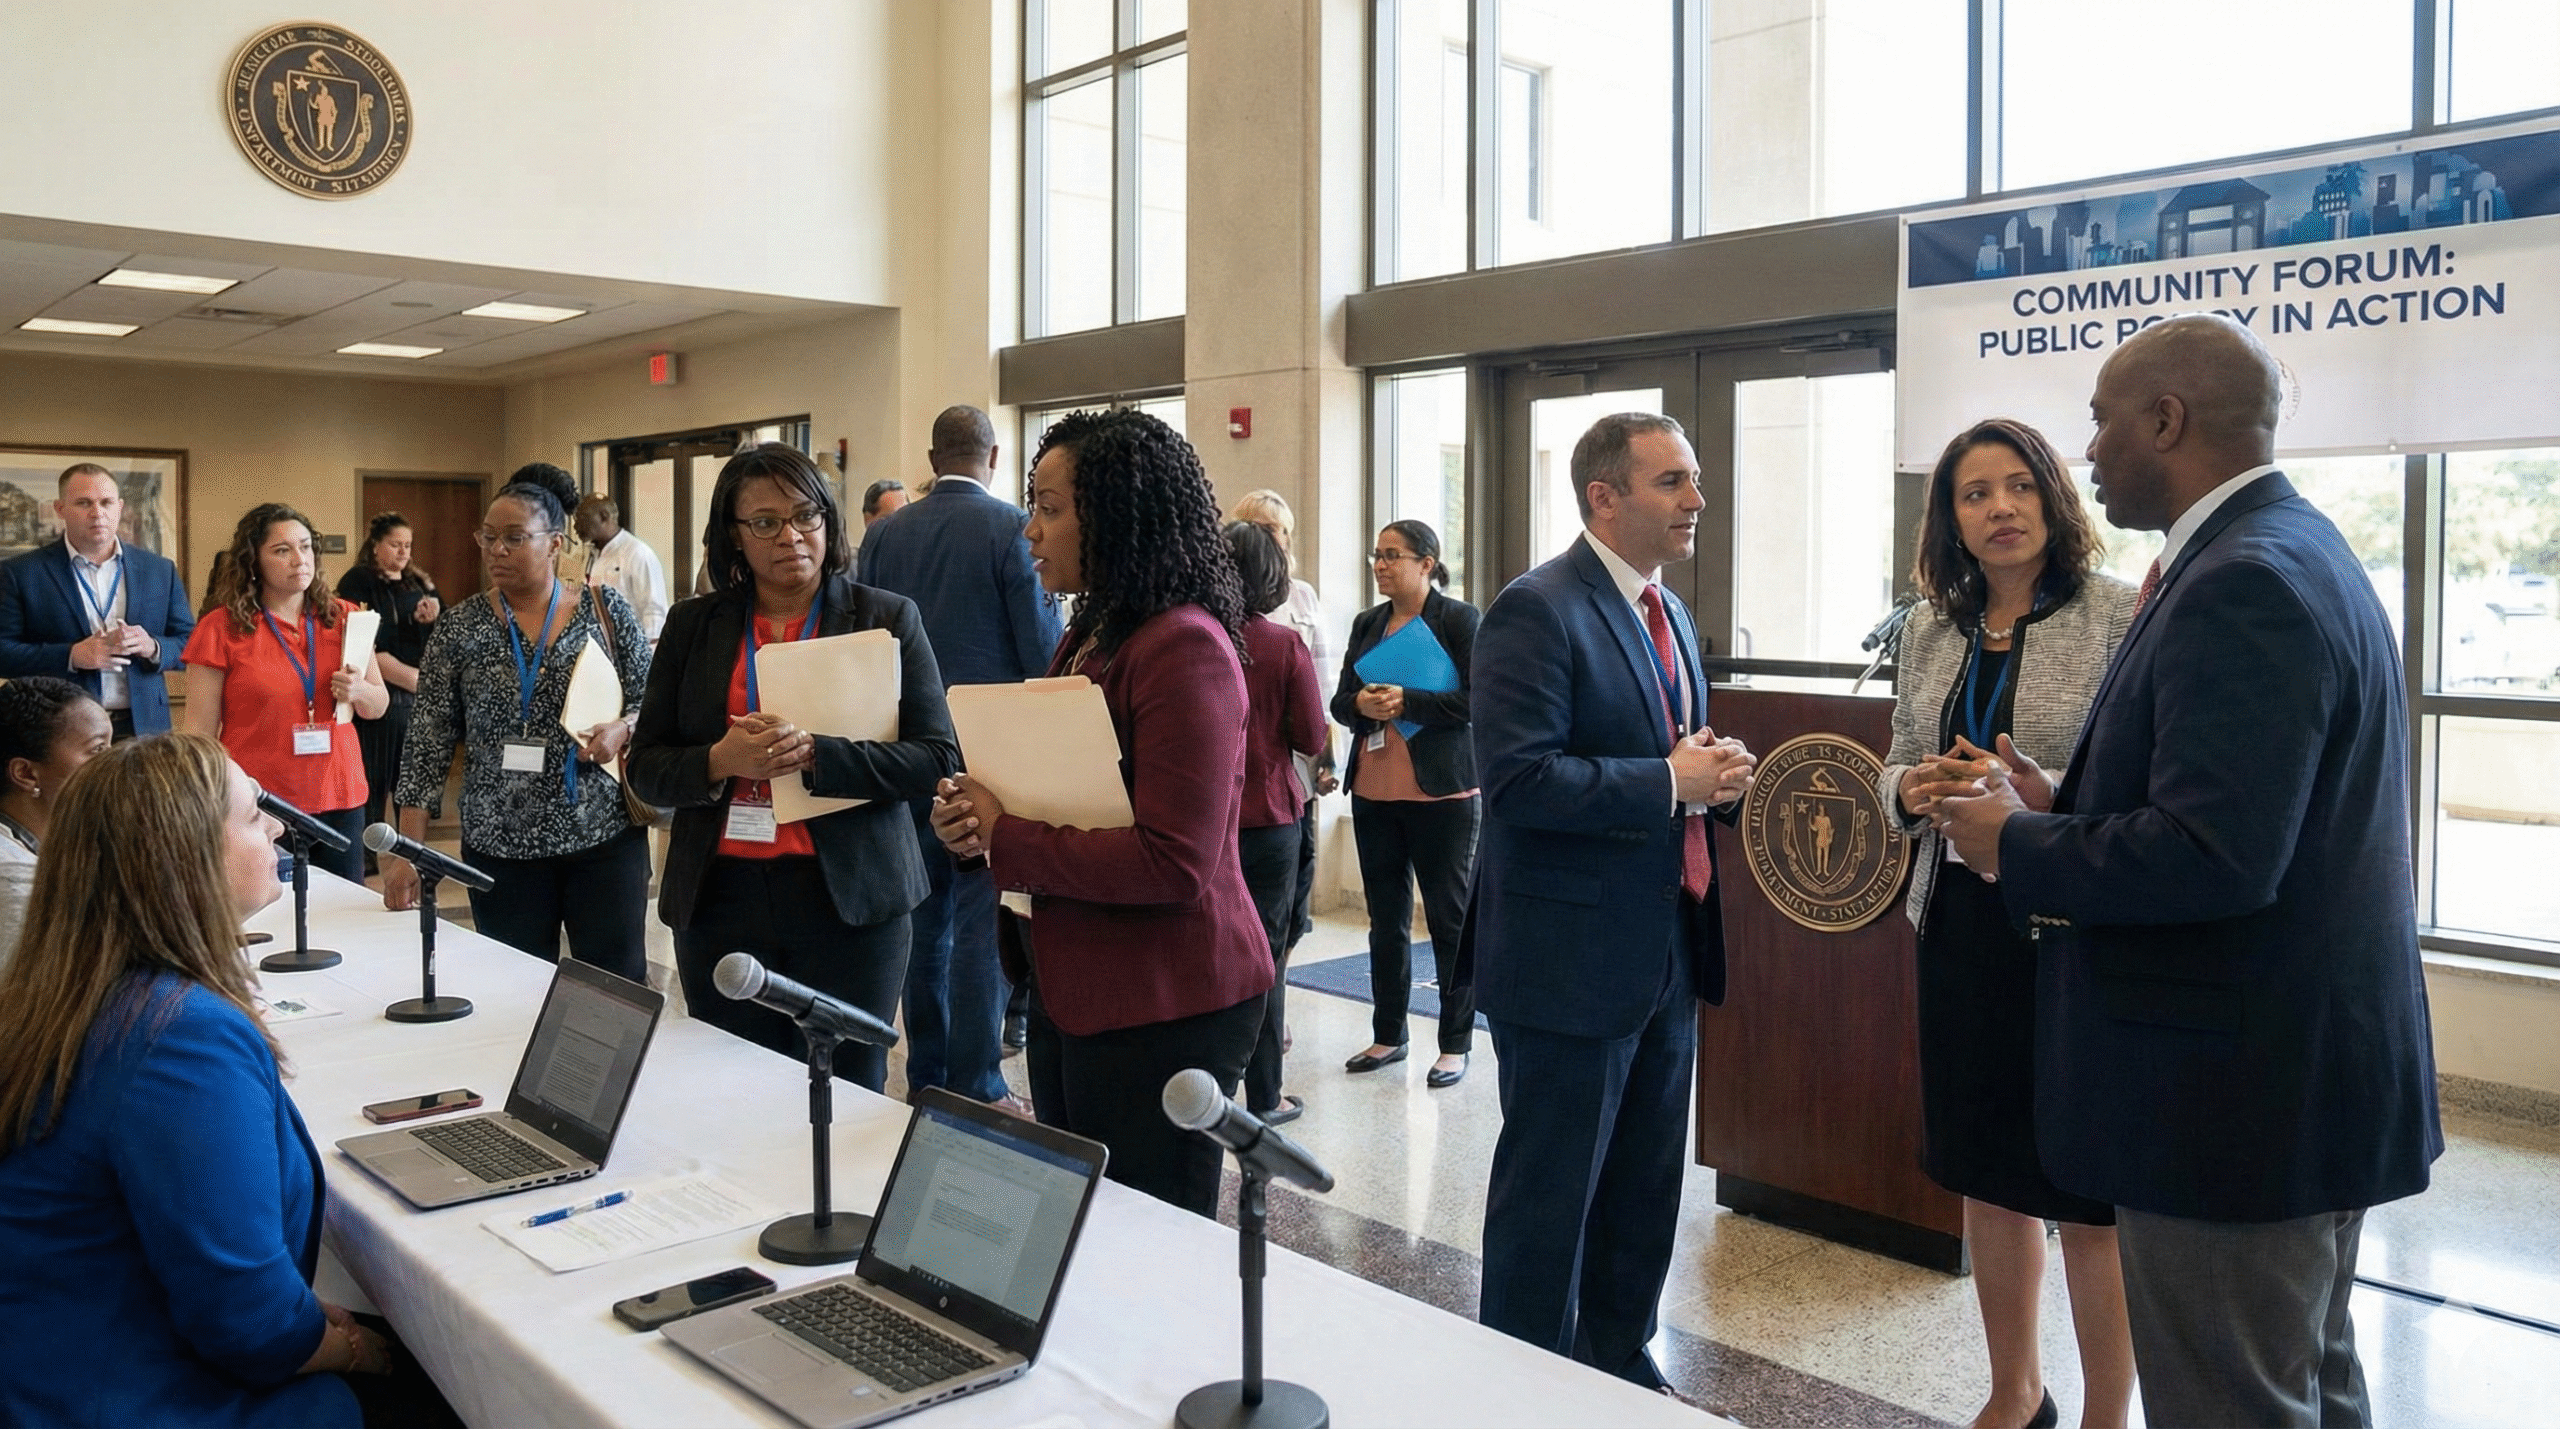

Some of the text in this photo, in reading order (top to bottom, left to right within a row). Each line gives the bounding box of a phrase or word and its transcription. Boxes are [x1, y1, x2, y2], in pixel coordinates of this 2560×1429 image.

[2013, 244, 2455, 316] COMMUNITY FORUM:
[1980, 321, 2103, 358] PUBLIC
[2272, 302, 2312, 334] IN
[2327, 282, 2505, 327] ACTION
